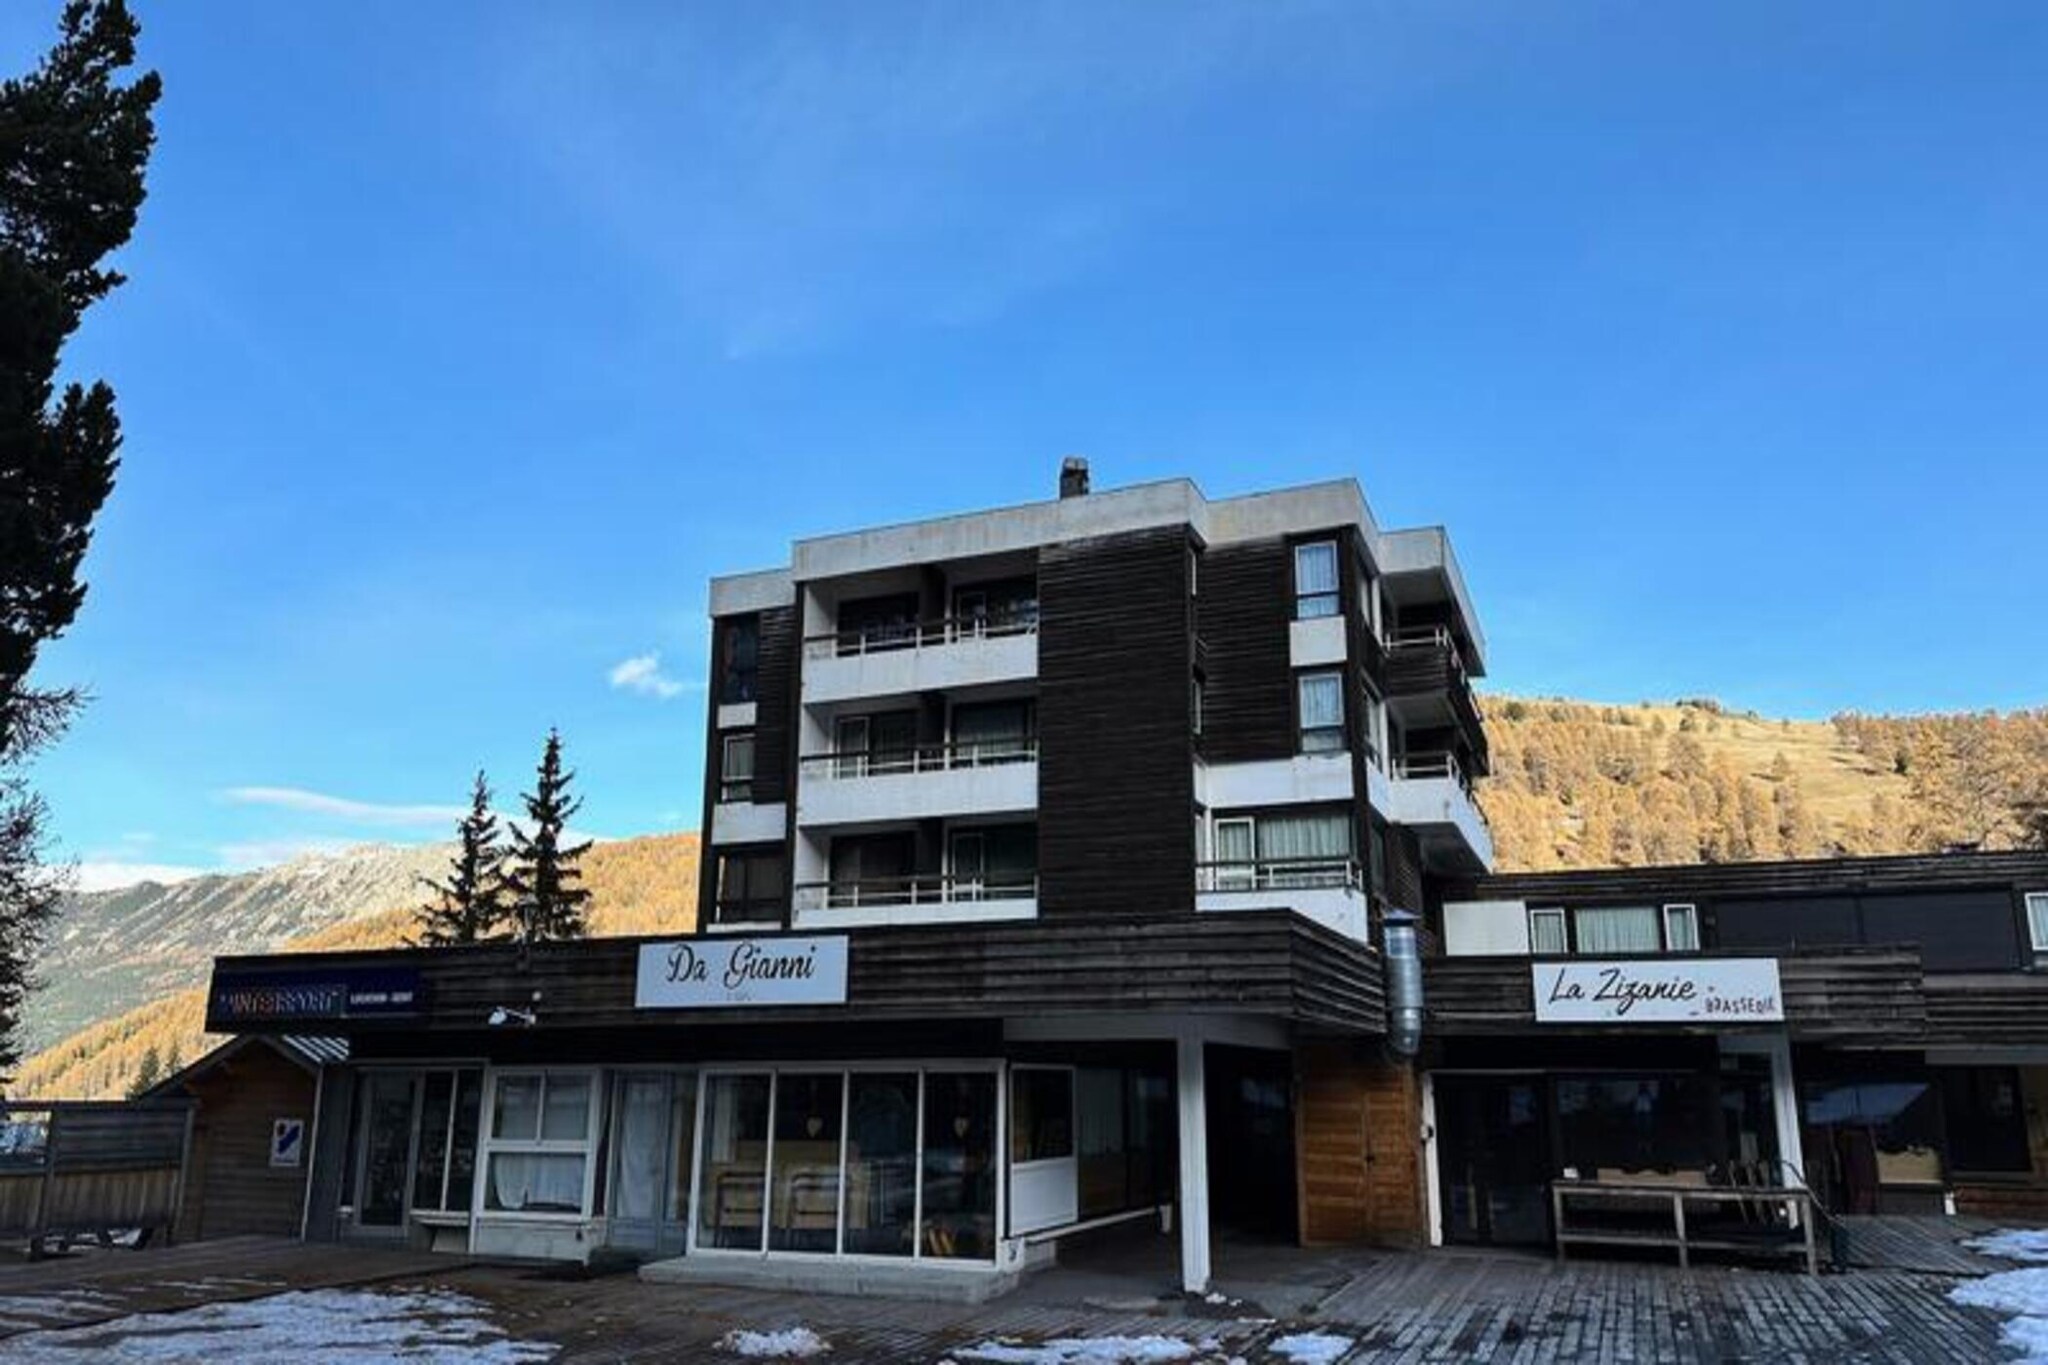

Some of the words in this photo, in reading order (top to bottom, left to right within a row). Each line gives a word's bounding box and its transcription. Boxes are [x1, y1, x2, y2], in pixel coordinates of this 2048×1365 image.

[665, 943, 709, 982] Da
[723, 942, 818, 989] Gianni
[1548, 967, 1585, 1004] La
[1593, 967, 1699, 1015] Zizanie
